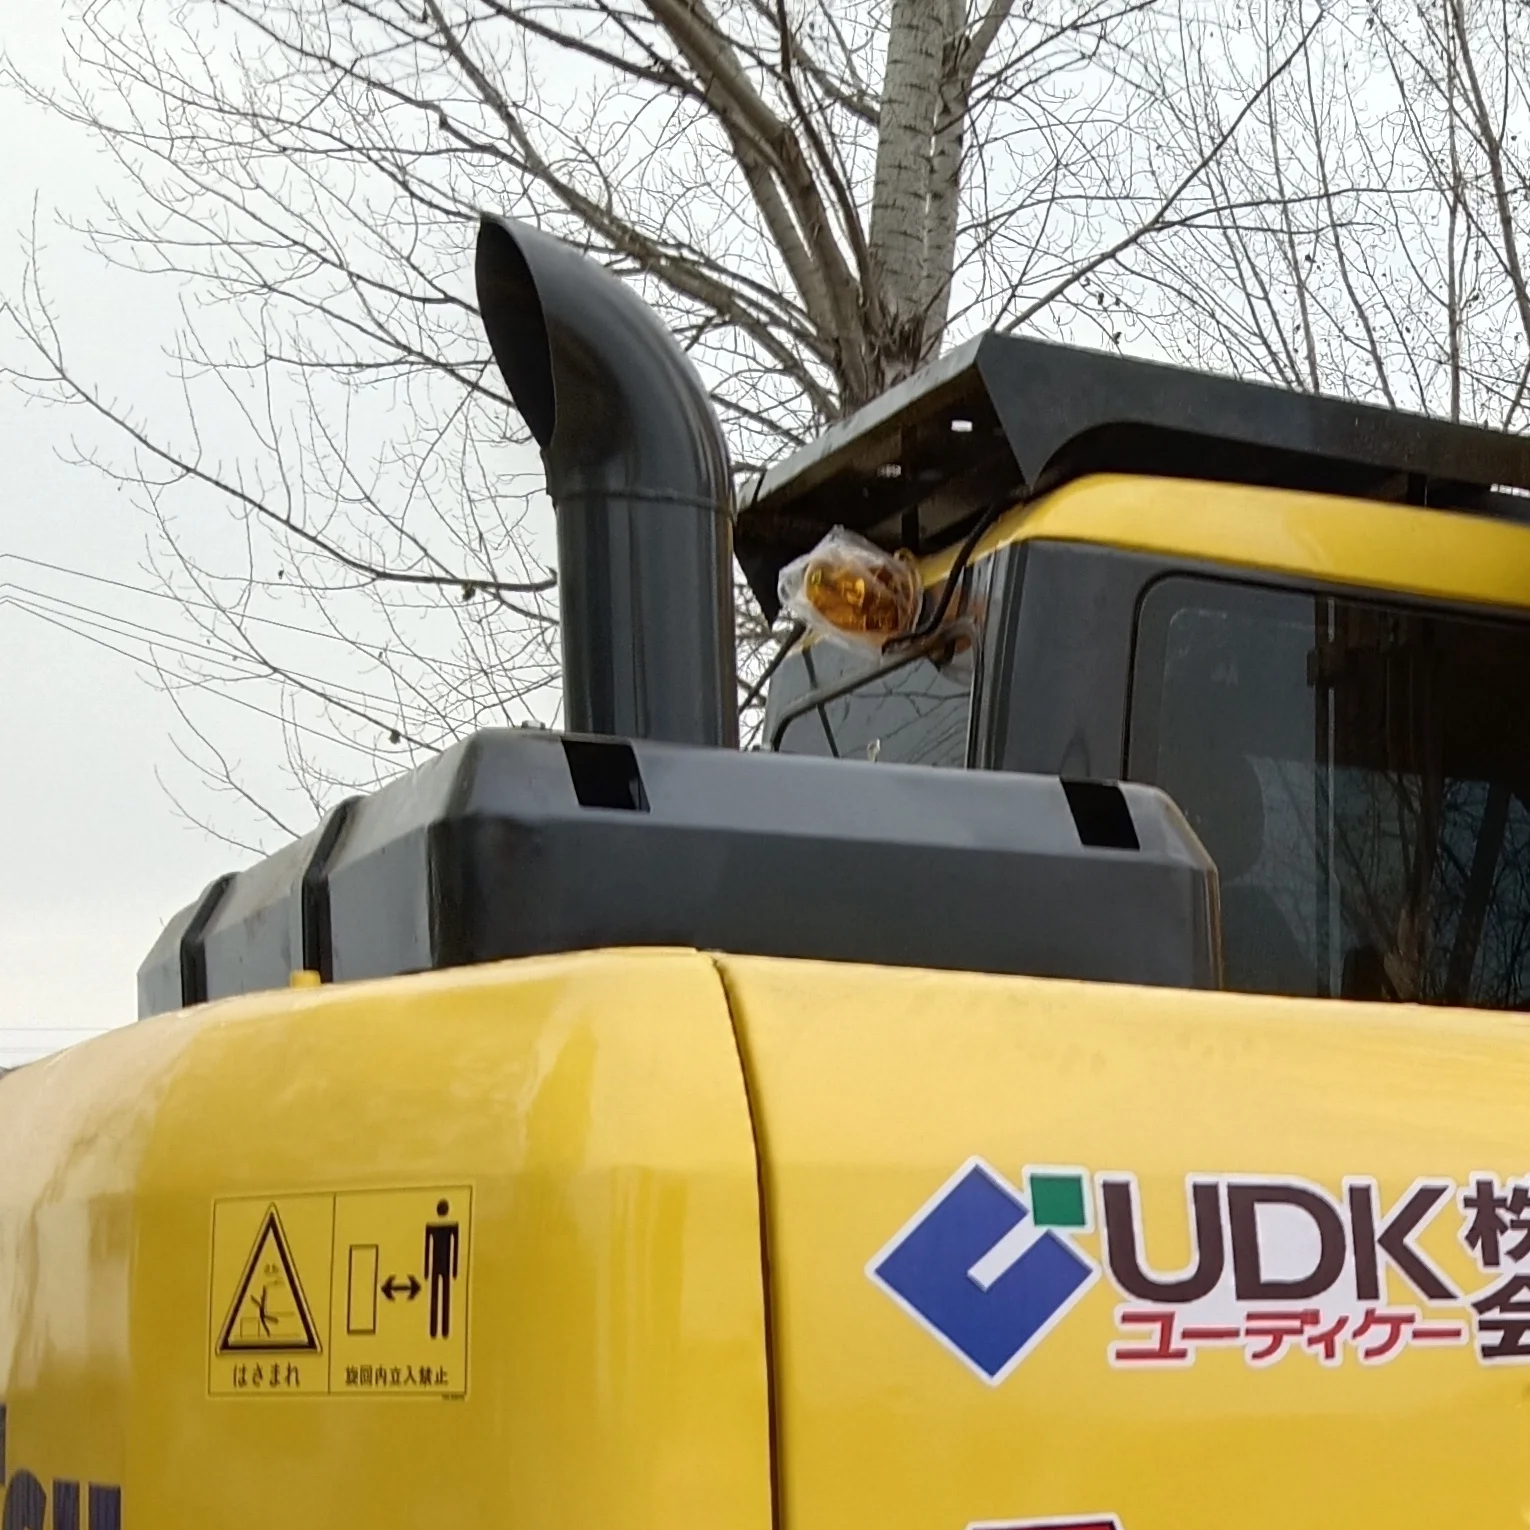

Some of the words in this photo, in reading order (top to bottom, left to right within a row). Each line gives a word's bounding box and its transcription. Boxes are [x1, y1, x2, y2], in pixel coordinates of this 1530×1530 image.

[1102, 1181, 1459, 1304] UDK
[1114, 1309, 1462, 1361] ユーディケー
